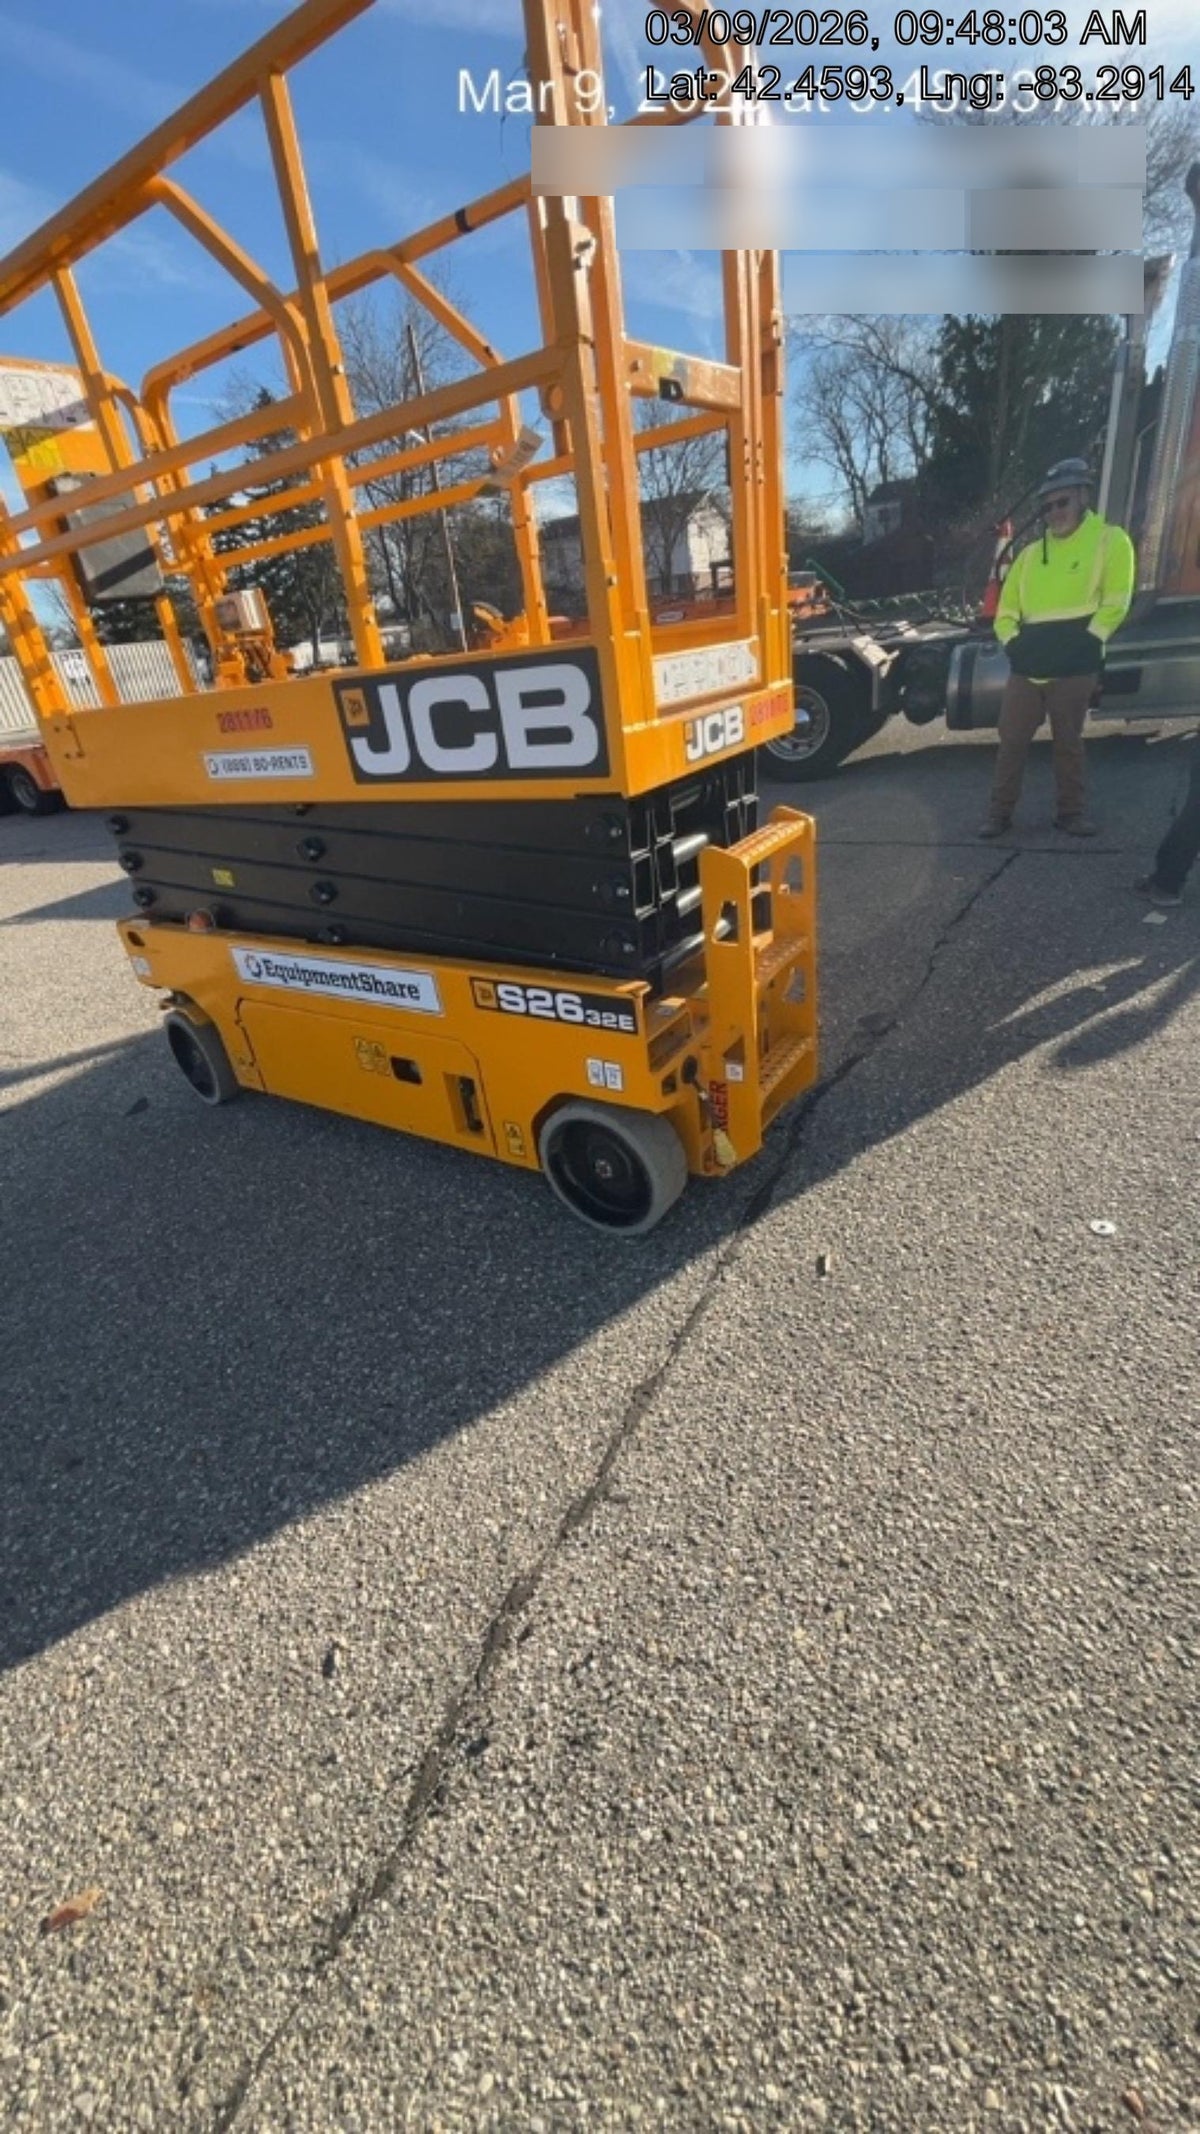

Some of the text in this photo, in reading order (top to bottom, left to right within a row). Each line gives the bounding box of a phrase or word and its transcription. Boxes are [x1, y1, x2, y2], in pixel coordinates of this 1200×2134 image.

[350, 663, 600, 776] JCB
[687, 705, 744, 762] JCB
[262, 958, 421, 1001] EquipmentShare
